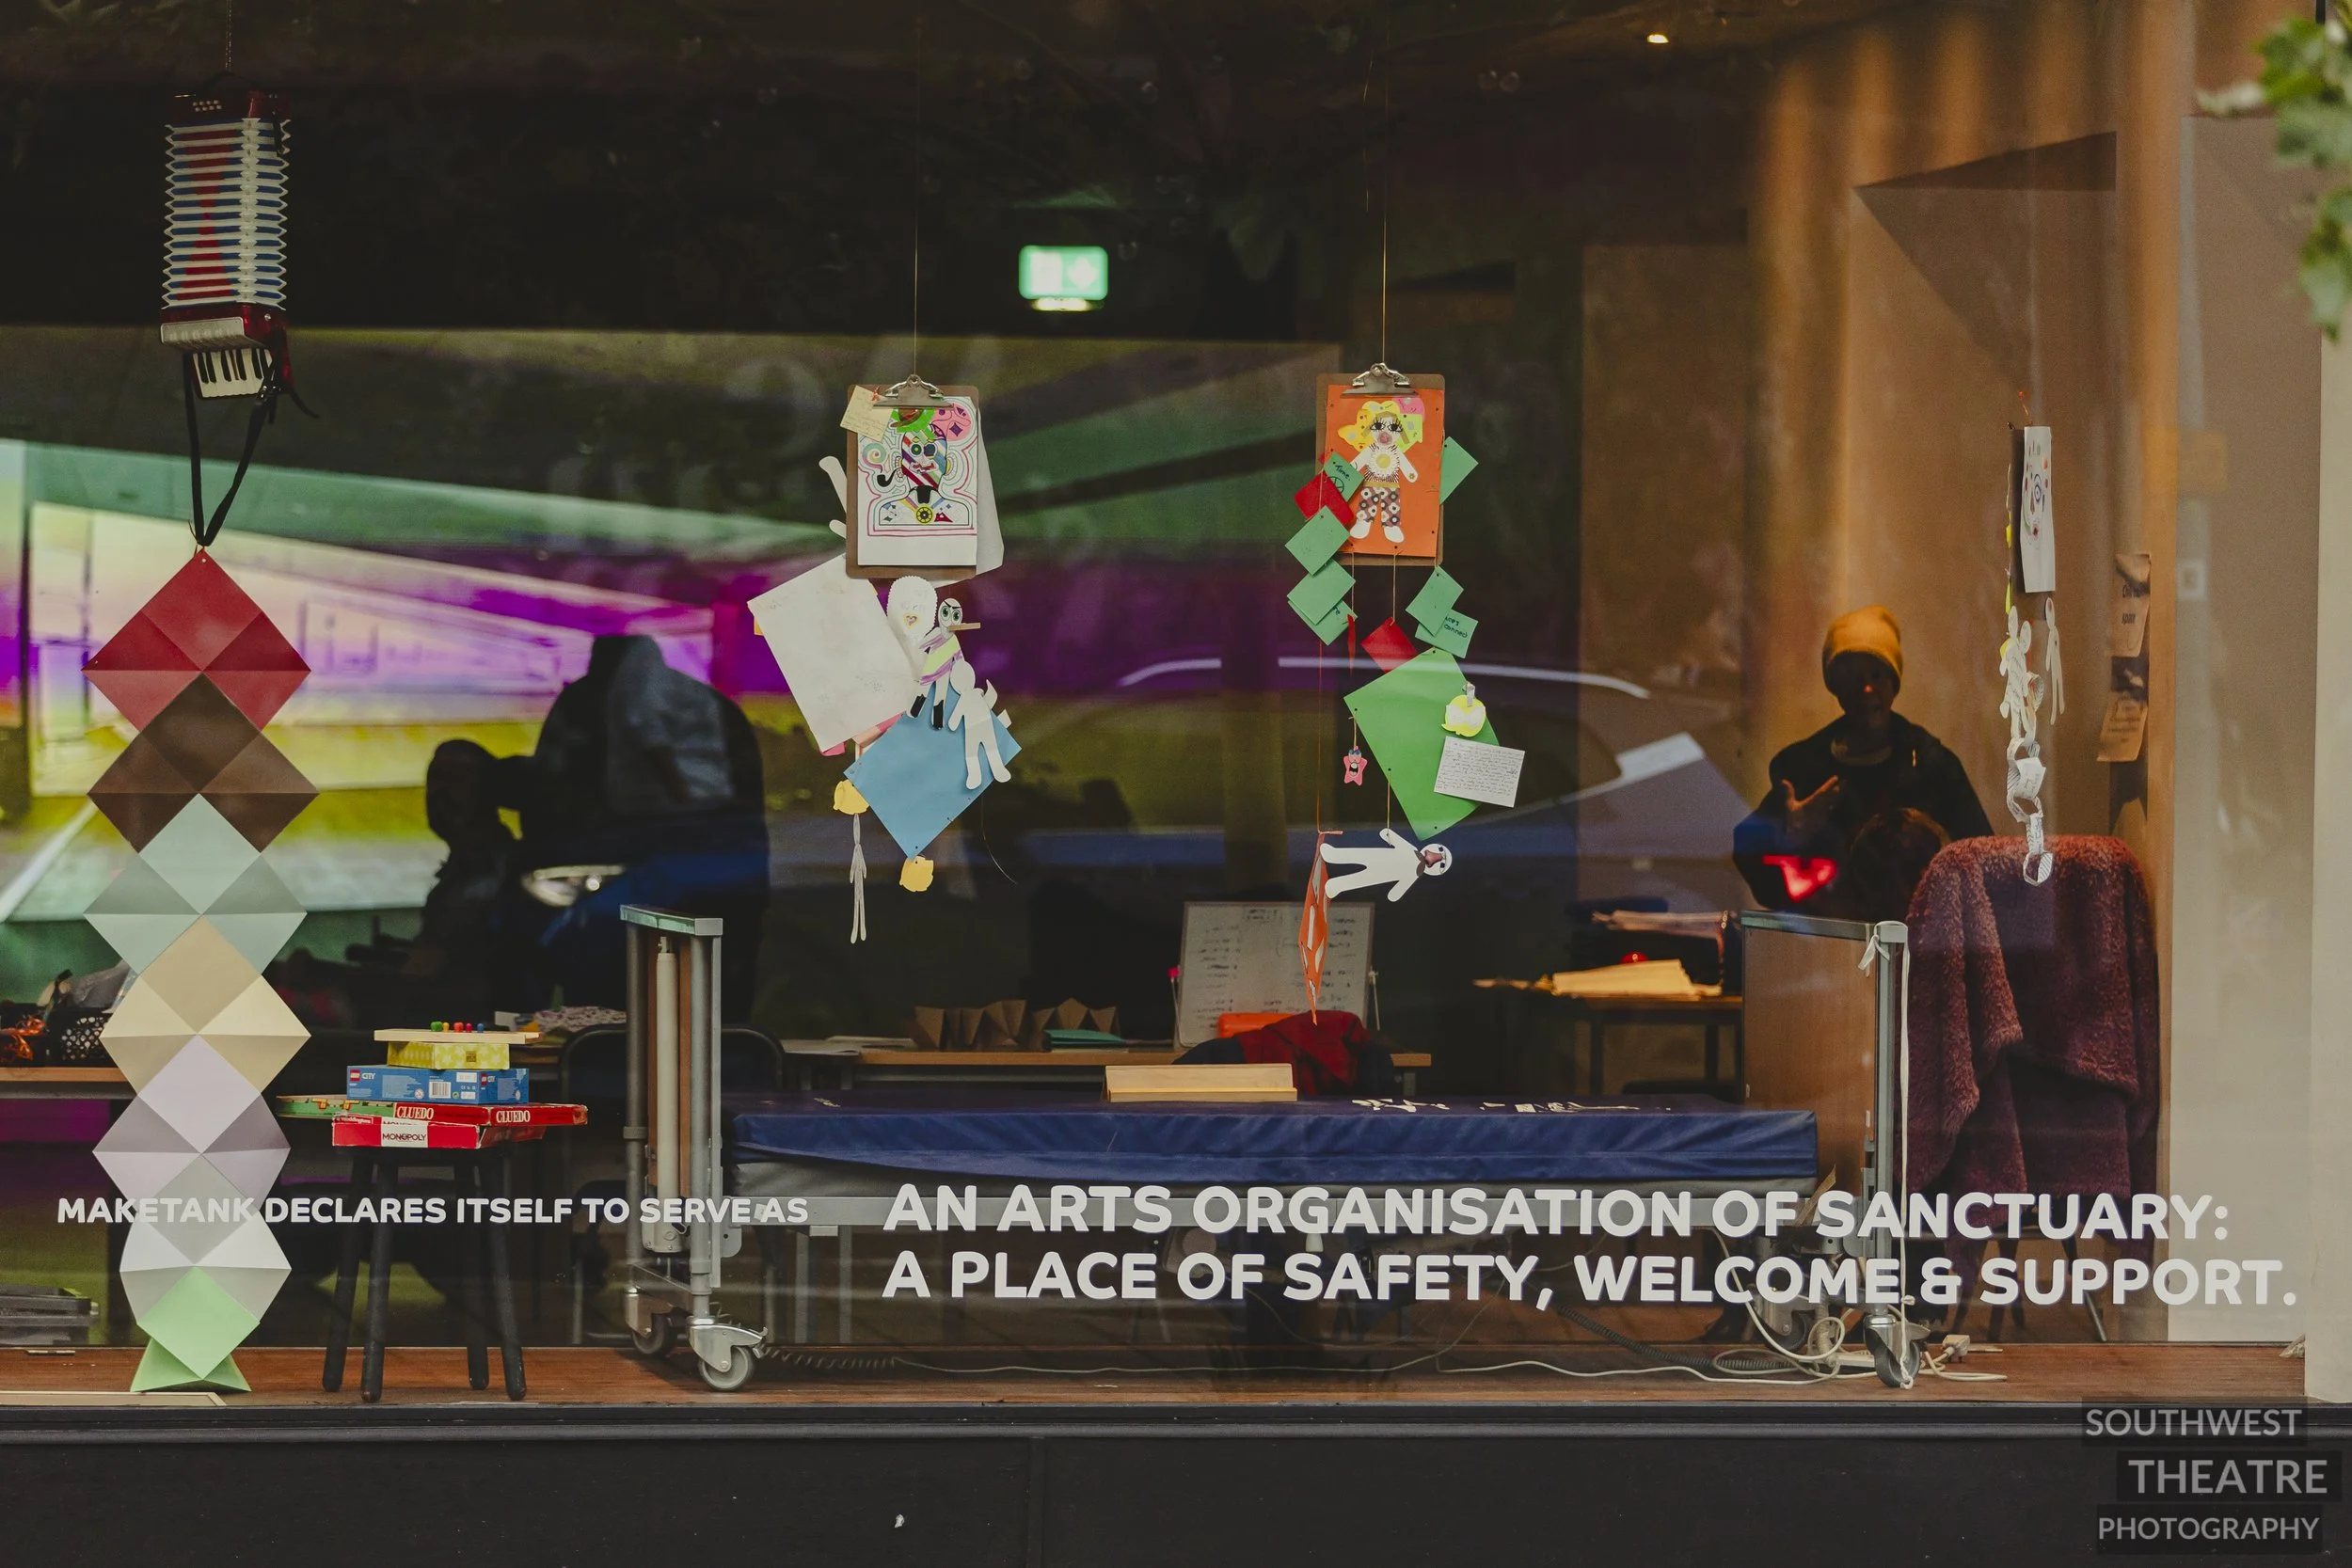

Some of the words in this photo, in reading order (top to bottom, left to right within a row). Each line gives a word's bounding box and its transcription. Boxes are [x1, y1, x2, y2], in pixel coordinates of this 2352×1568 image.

[396, 1105, 435, 1120] CLUEDO
[496, 1110, 531, 1123] CLUEDO
[382, 1132, 426, 1141] MONOPOLY
[57, 1197, 255, 1223] MAKETANK
[265, 1197, 447, 1224] DECLARES
[457, 1197, 573, 1224] ITSELF
[581, 1197, 630, 1224] TO
[639, 1197, 751, 1224] SERVE
[759, 1197, 809, 1224] AS
[882, 1183, 977, 1231] AN
[996, 1184, 1172, 1233] ARTS
[1193, 1185, 1691, 1237] ORGANISATION
[1711, 1190, 1799, 1238] OF
[1816, 1190, 2229, 1241] SANCTUARY:
[882, 1250, 931, 1298] A
[951, 1251, 1157, 1300] PLACE
[1177, 1252, 1265, 1300] OF
[1283, 1253, 1553, 1311] SAFETY,
[1574, 1255, 1899, 1304] WELCOME
[1920, 1257, 1962, 1305] &
[1979, 1258, 2296, 1307] SUPPORT.
